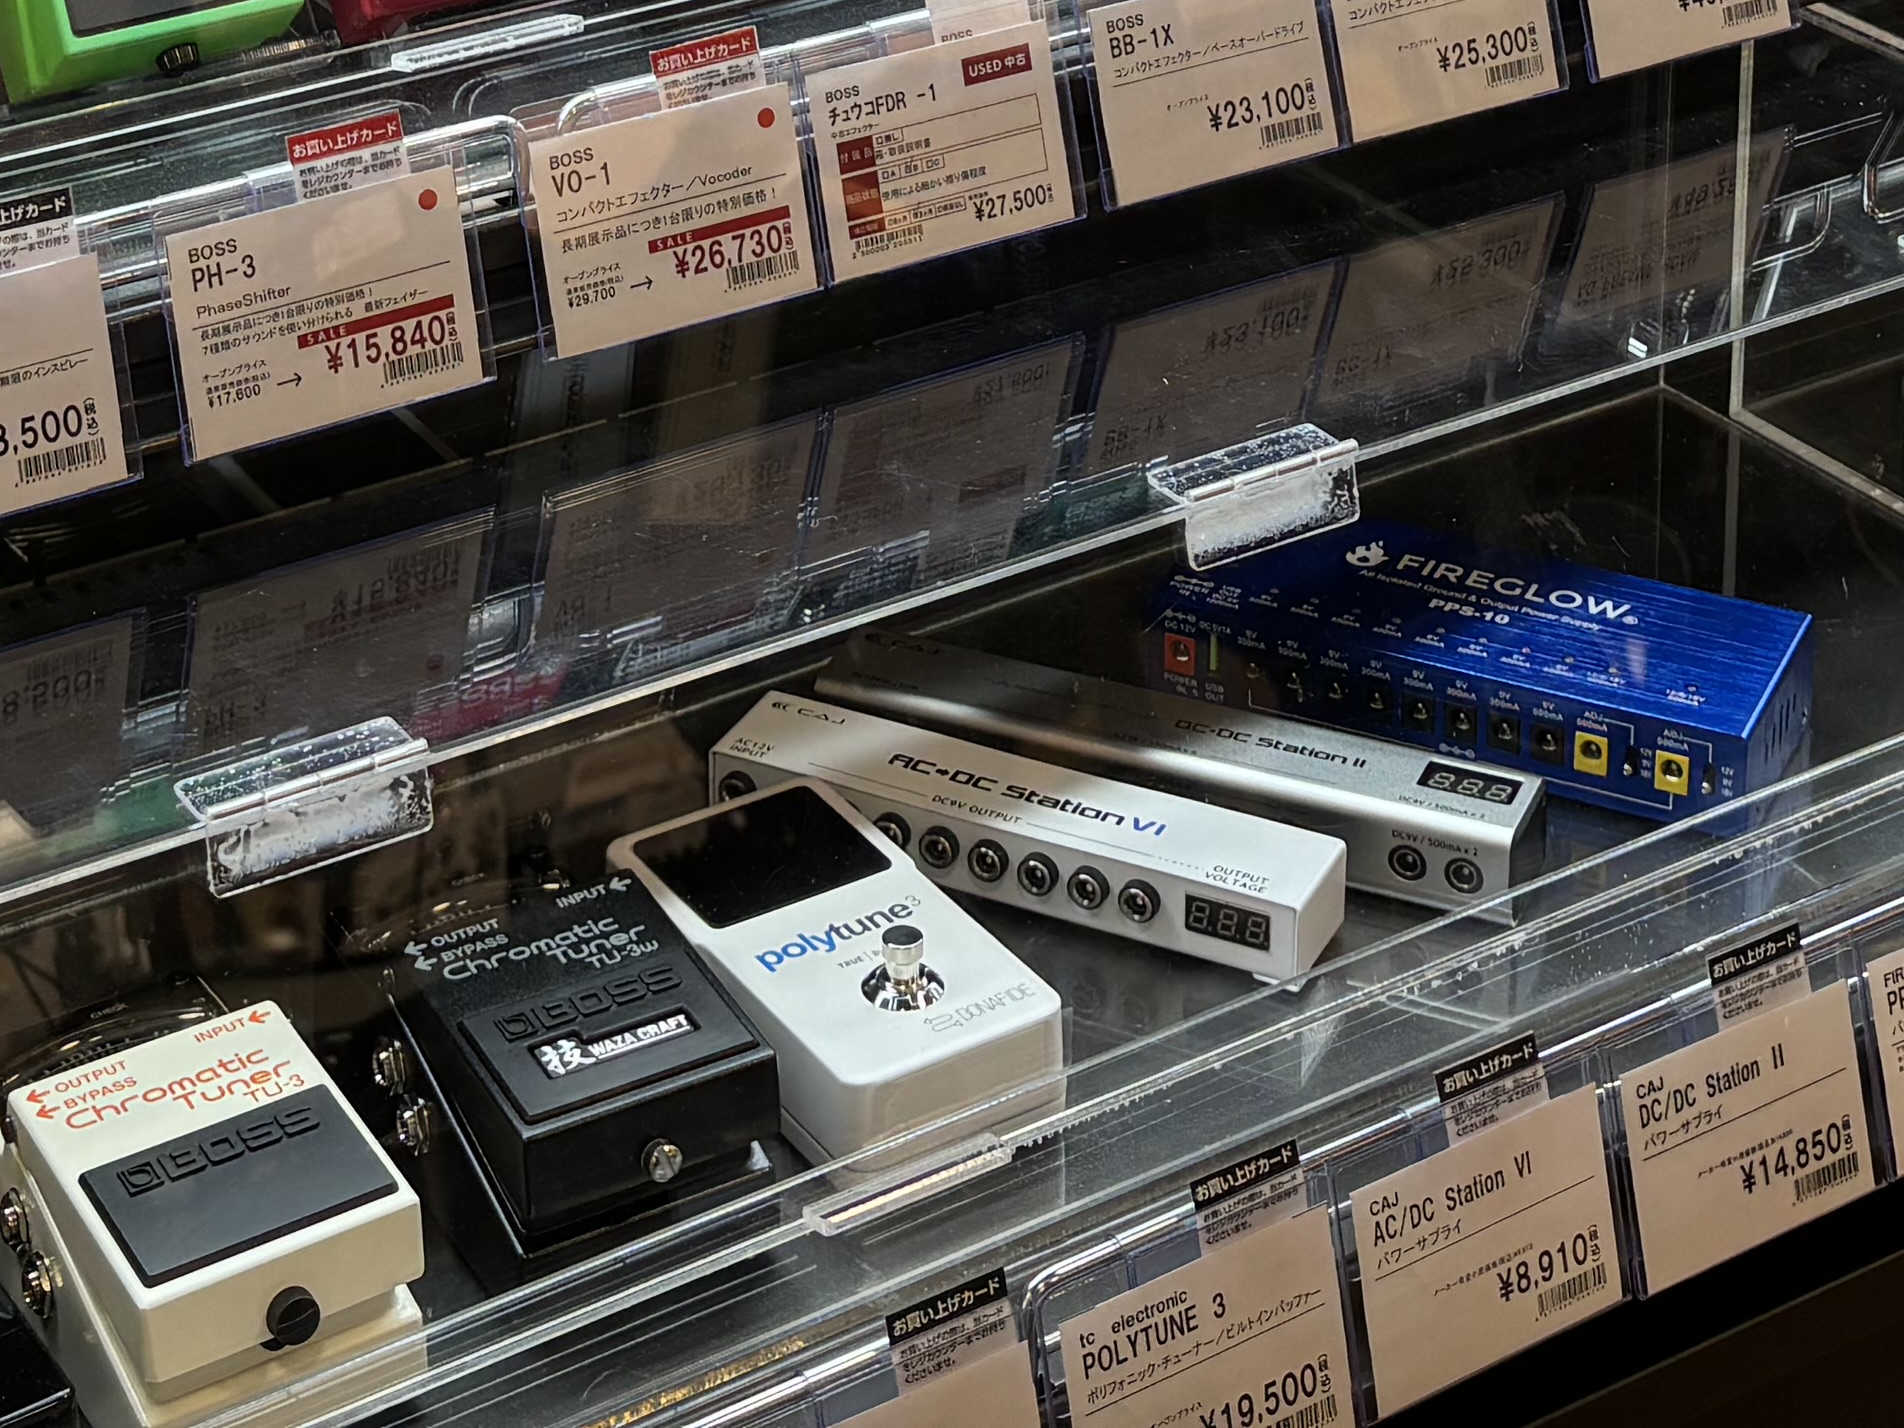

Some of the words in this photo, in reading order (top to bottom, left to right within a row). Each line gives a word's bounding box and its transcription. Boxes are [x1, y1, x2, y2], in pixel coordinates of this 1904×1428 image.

[1208, 82, 1304, 132] ¥23,100
[552, 162, 612, 198] VO-1
[674, 224, 783, 278] ¥26,730
[326, 316, 446, 375] ¥15,840
[1396, 552, 1628, 620] FIREGLOW
[756, 902, 914, 974] polytune
[66, 1049, 271, 1132] Chromatic
[171, 1059, 293, 1115] Tuner
[1741, 1123, 1841, 1193] ¥14,850
[1372, 1200, 1436, 1247] AC/DC
[1446, 1167, 1505, 1210] Station
[1517, 1151, 1532, 1175] VI
[1497, 1233, 1588, 1300] ¥8,910
